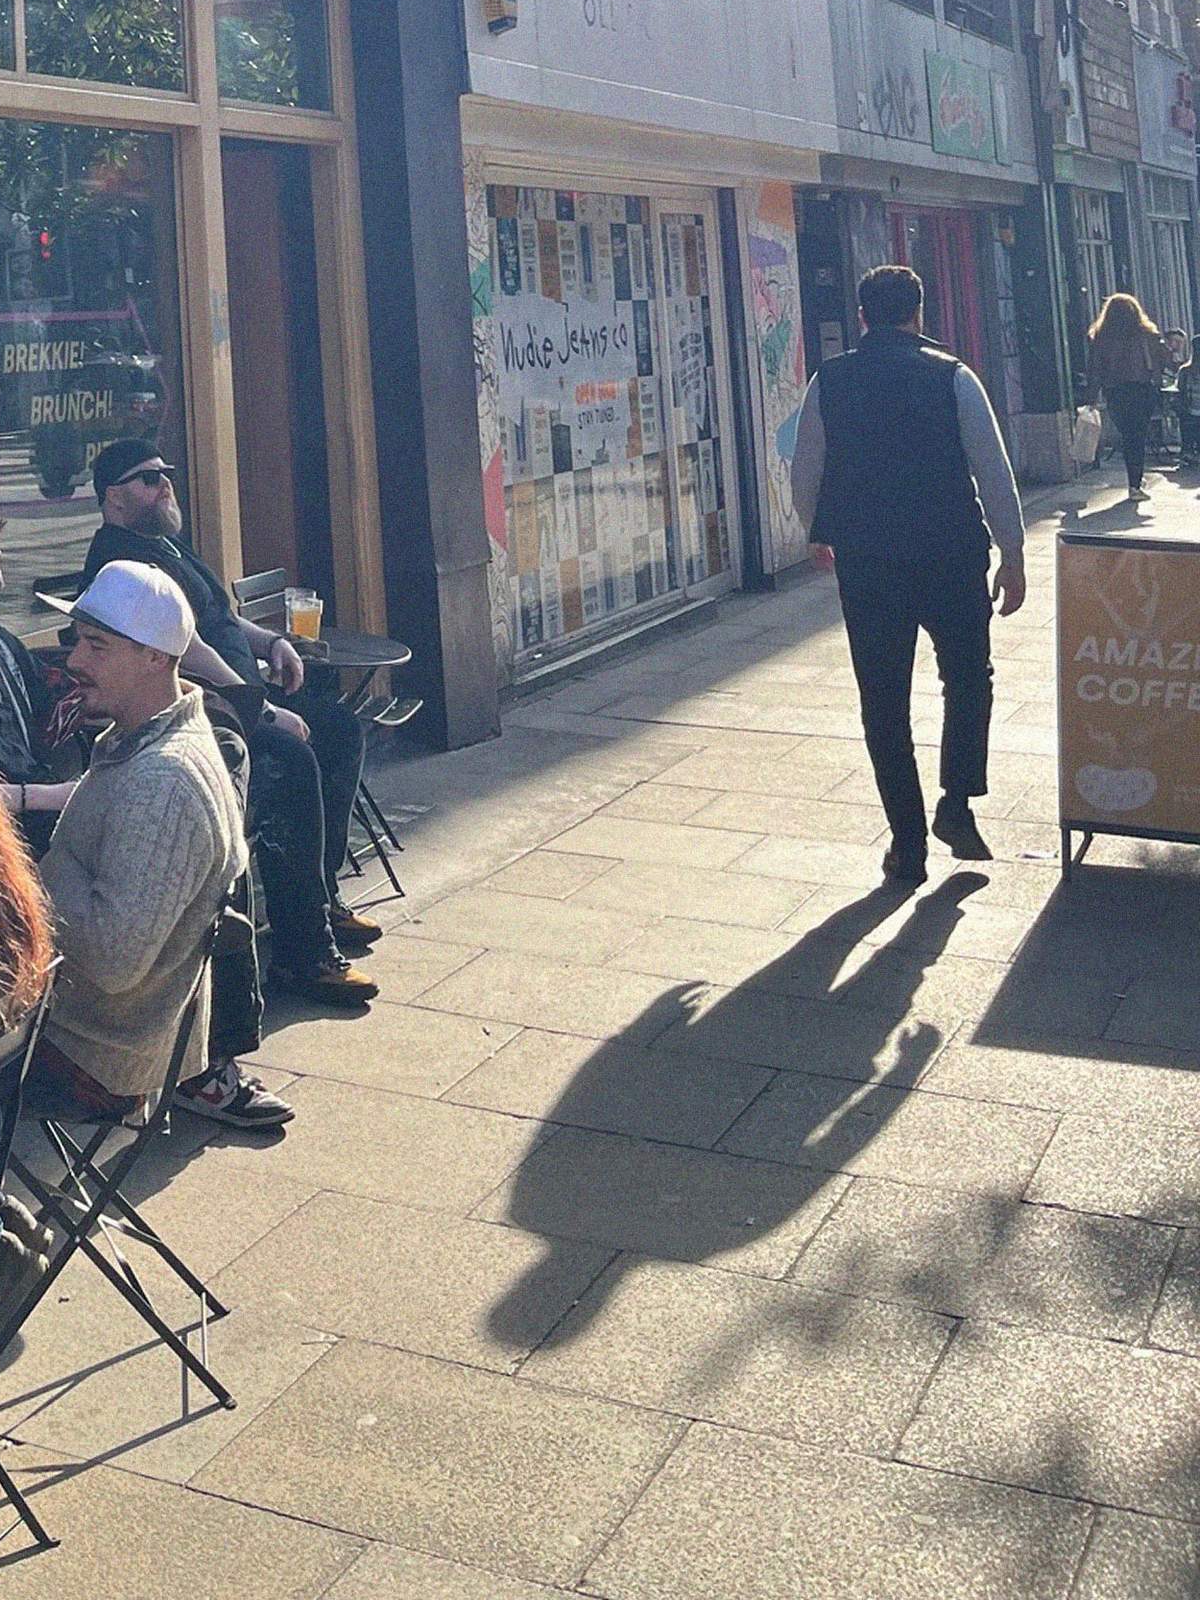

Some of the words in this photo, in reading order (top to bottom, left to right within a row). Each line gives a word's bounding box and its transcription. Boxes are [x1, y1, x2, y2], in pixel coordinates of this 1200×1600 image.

[3, 340, 85, 374] BREKKIE!
[500, 320, 554, 374] Nudie
[30, 389, 113, 426] BRUNCH!
